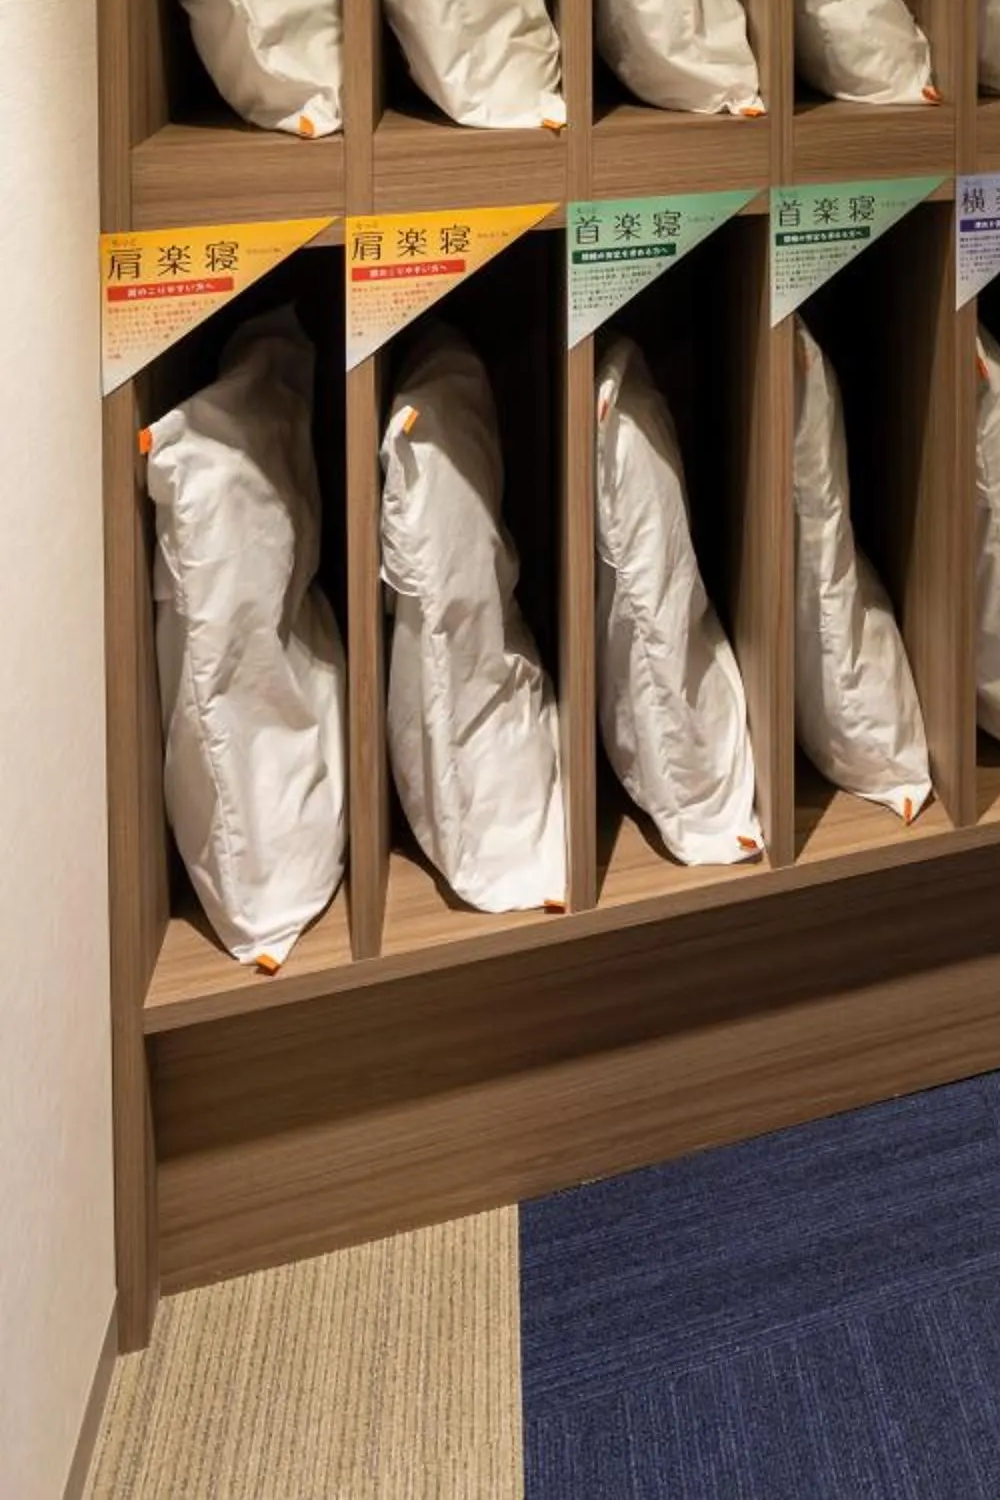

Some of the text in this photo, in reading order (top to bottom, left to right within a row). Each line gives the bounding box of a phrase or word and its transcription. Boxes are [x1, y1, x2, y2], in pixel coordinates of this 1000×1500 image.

[575, 208, 682, 244] 首楽寝
[776, 195, 876, 227] 首楽寝
[351, 224, 471, 260] 肩楽寝
[107, 241, 239, 280] 肩楽寝
